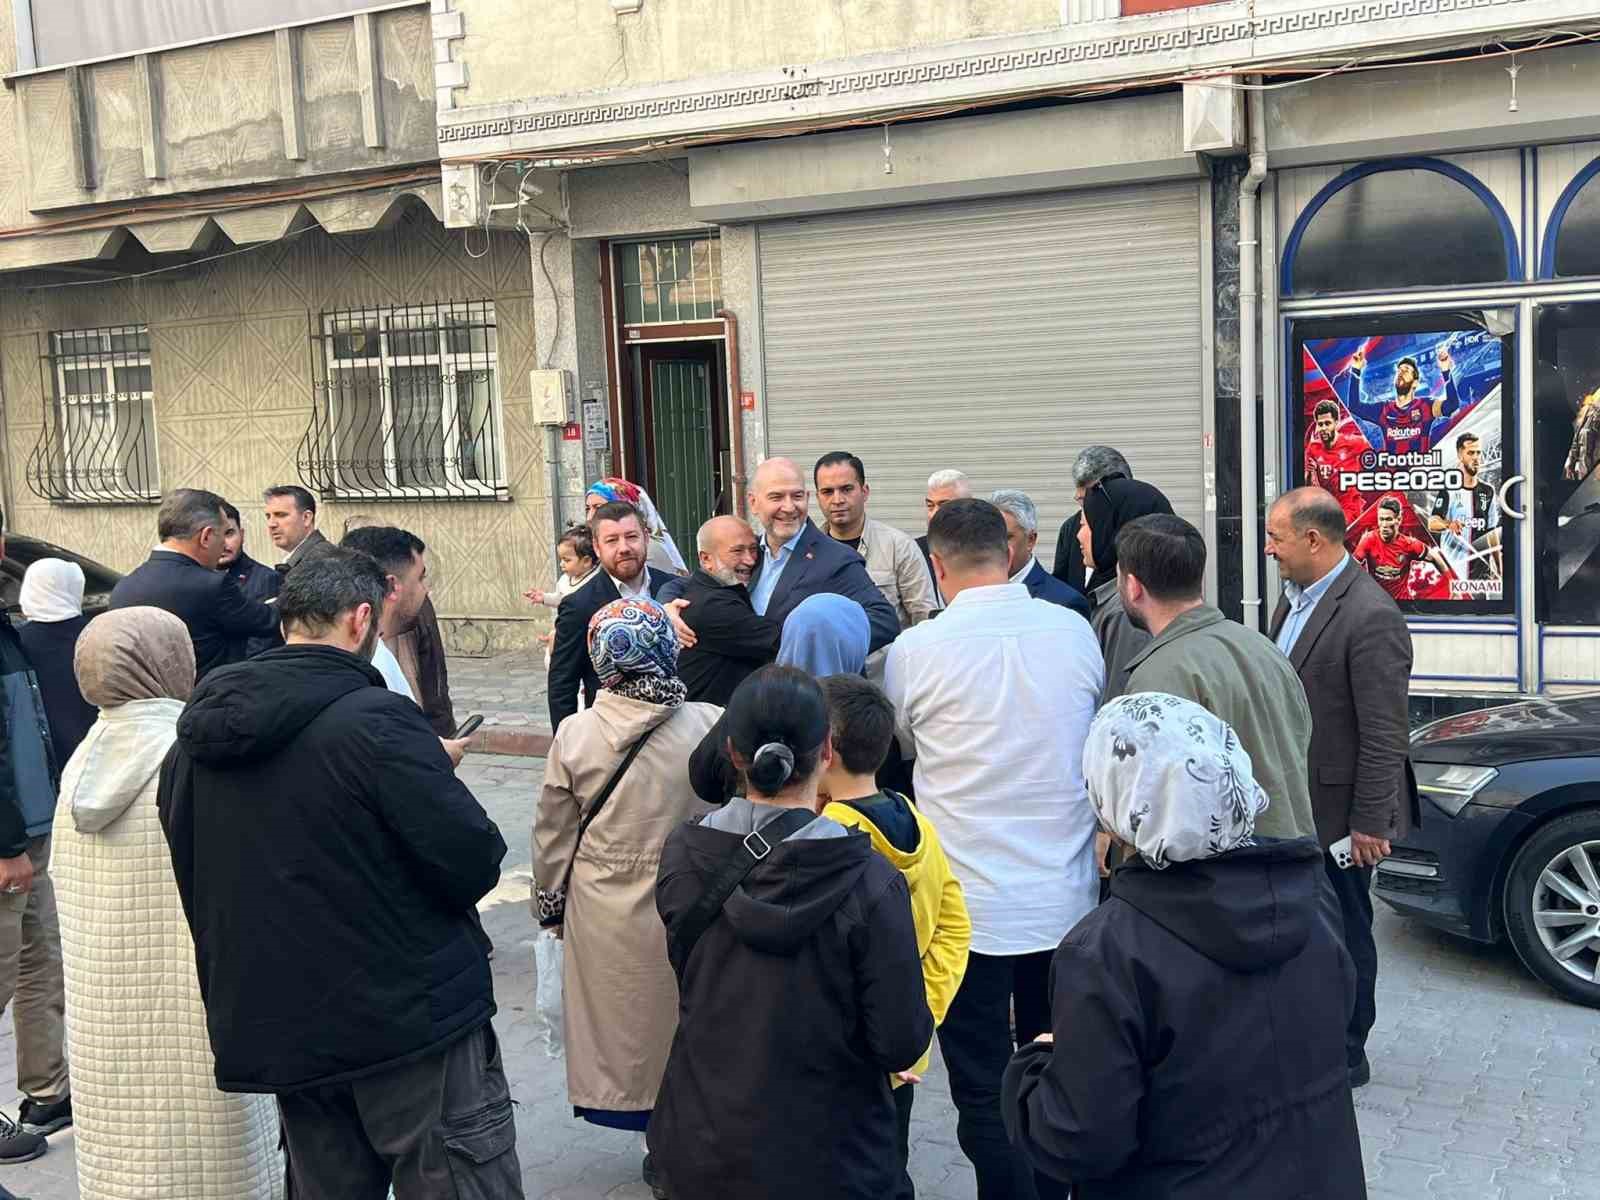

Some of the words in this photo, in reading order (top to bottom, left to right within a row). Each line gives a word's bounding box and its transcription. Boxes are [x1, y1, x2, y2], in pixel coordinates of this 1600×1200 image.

[1387, 427, 1421, 438] Rakuten
[1339, 470, 1463, 491] PES2020
[1463, 517, 1486, 531] eep
[1451, 581, 1502, 592] KONAMI
